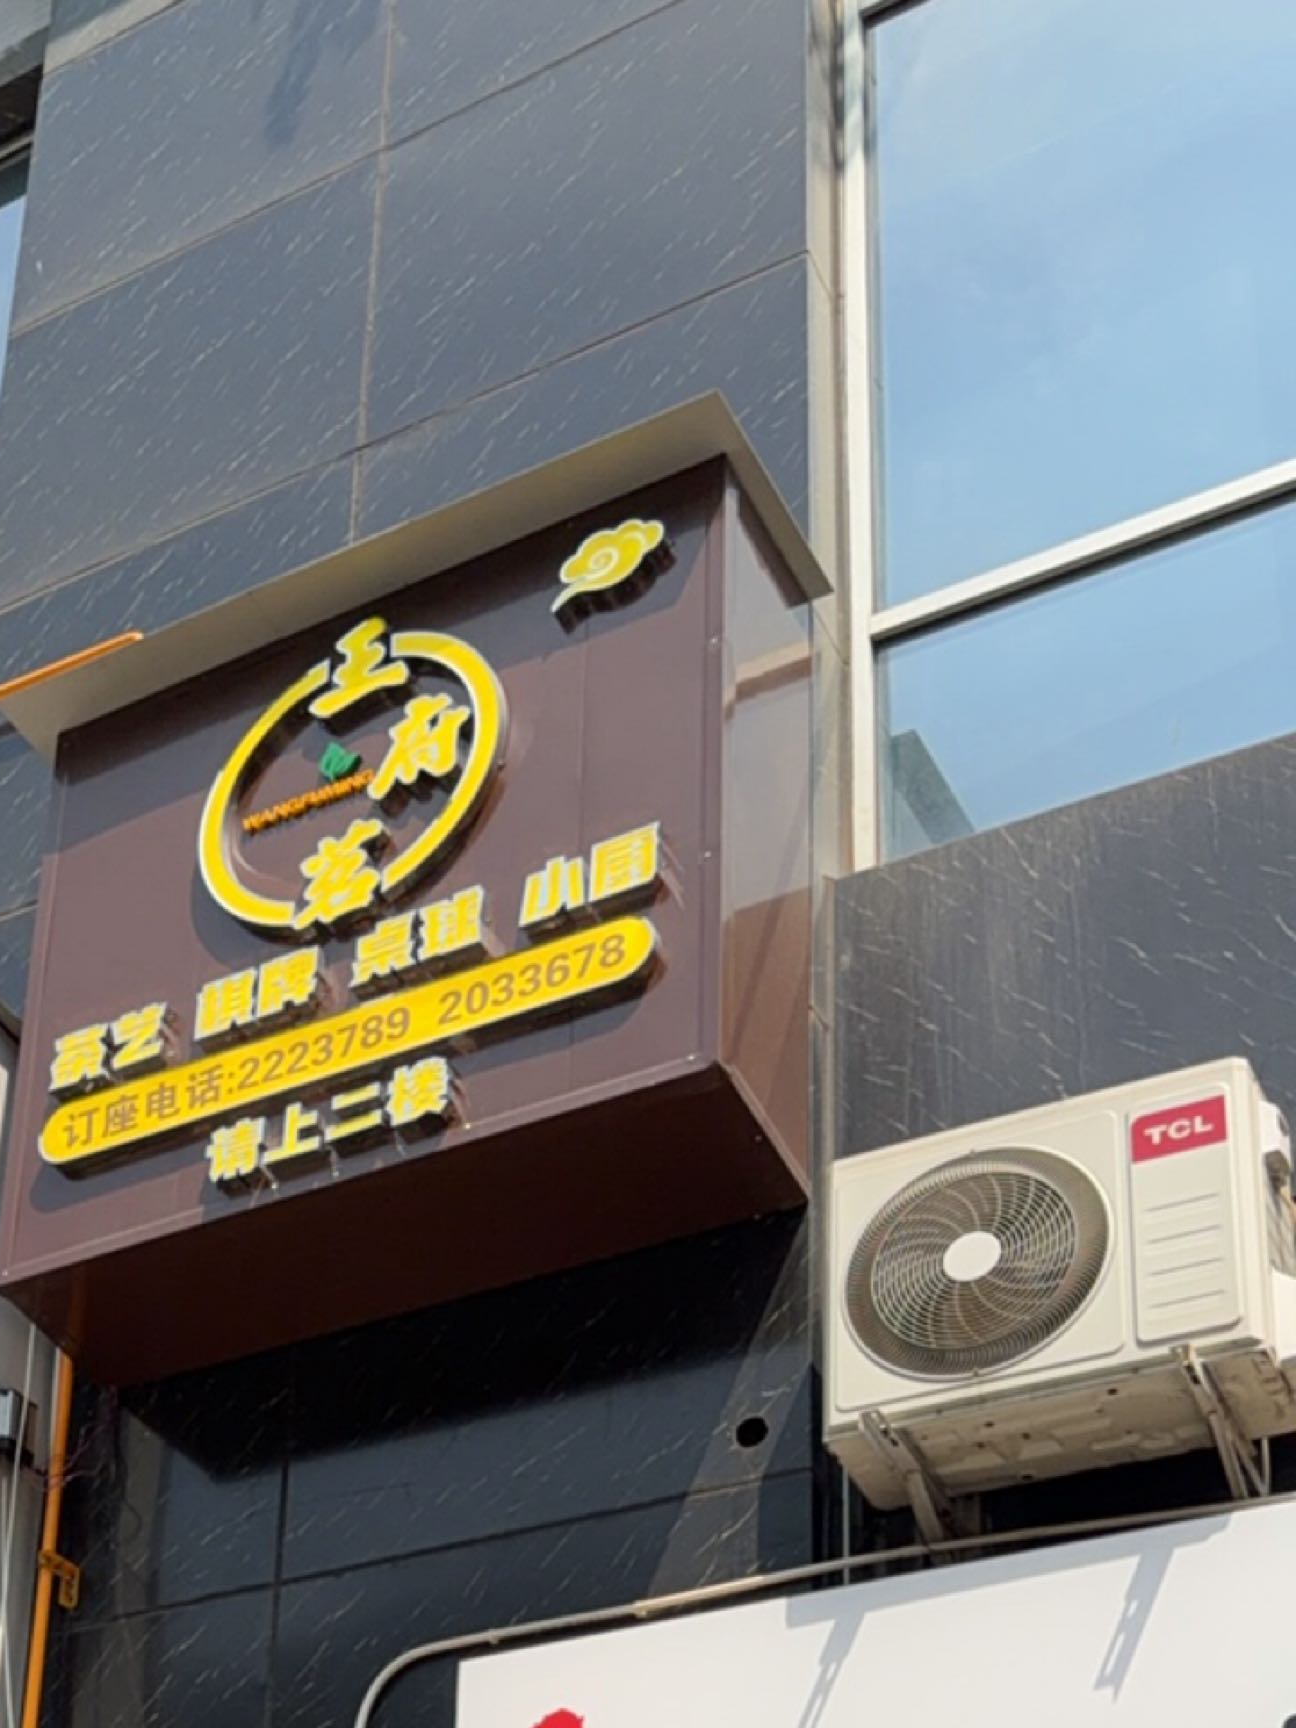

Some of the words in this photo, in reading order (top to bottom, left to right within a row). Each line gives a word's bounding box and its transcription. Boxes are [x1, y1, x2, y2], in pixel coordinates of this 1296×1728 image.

[194, 945, 319, 1042] 棋牌
[349, 885, 484, 987] 桌球
[437, 934, 625, 1026] 2033678
[205, 1056, 448, 1183] 请上二楼
[1144, 1115, 1213, 1145] TCL
